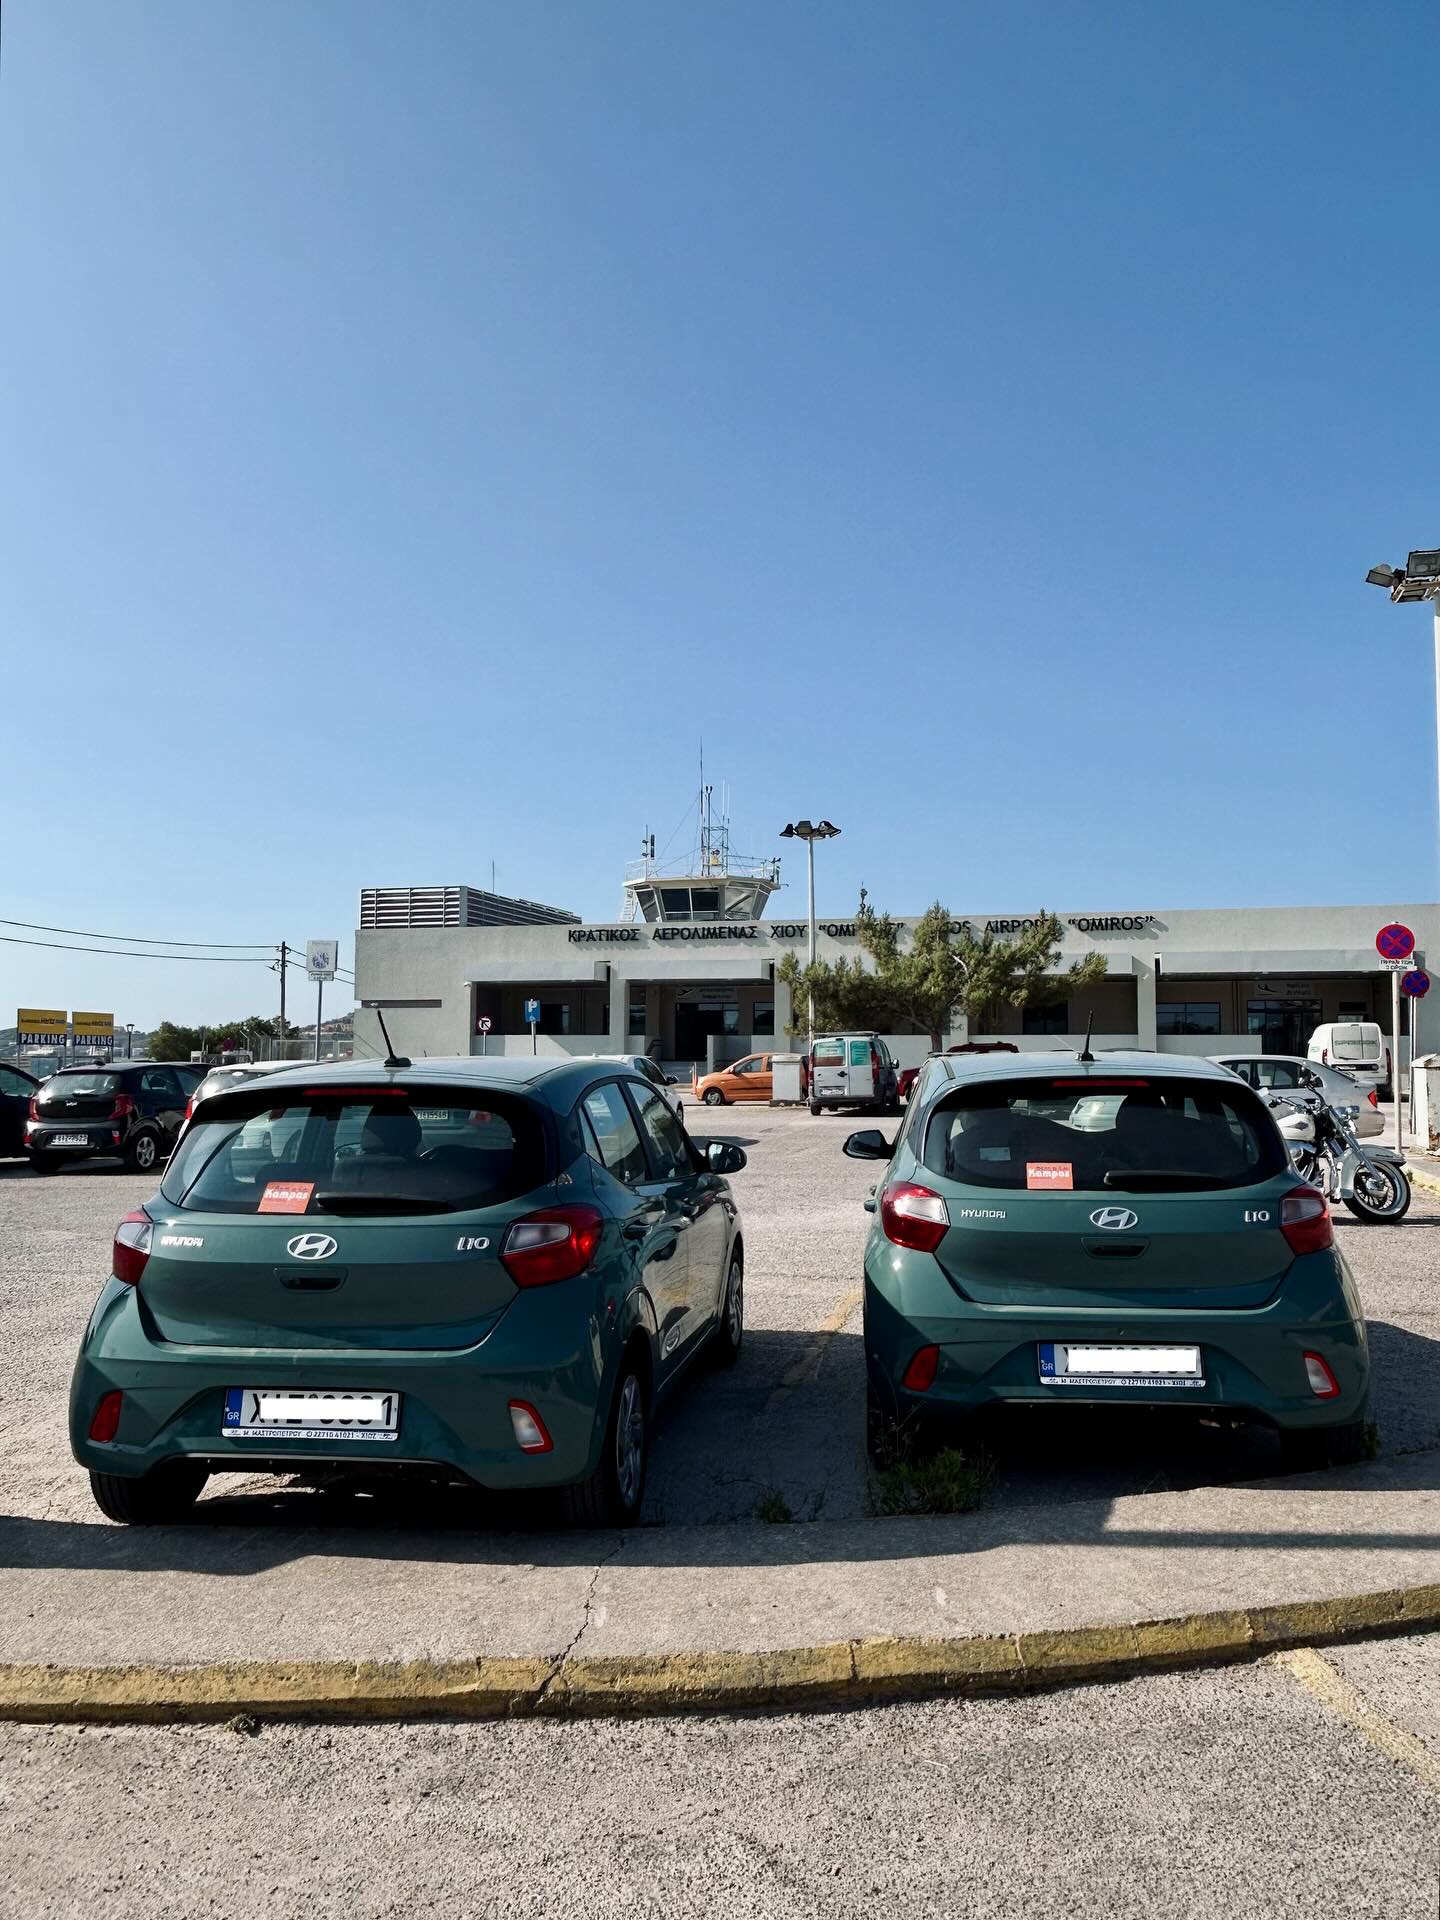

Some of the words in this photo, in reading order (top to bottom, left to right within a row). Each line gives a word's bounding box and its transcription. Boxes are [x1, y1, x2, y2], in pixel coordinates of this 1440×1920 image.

[568, 928, 641, 942] ΚΡΑΤΙΚΟΣ
[652, 925, 758, 940] ΑΕΡΟΛΙΜΕΝΑΣ
[770, 924, 807, 938] ΧΙΟΥ
[21, 1033, 65, 1044] PARKING
[75, 1035, 113, 1046] PARKING
[1028, 1168, 1070, 1180] Kampas
[263, 1188, 309, 1201] Kampas
[960, 1208, 1006, 1219] HYUNDAI
[1042, 1362, 1054, 1370] GR
[227, 1412, 240, 1420] GR
